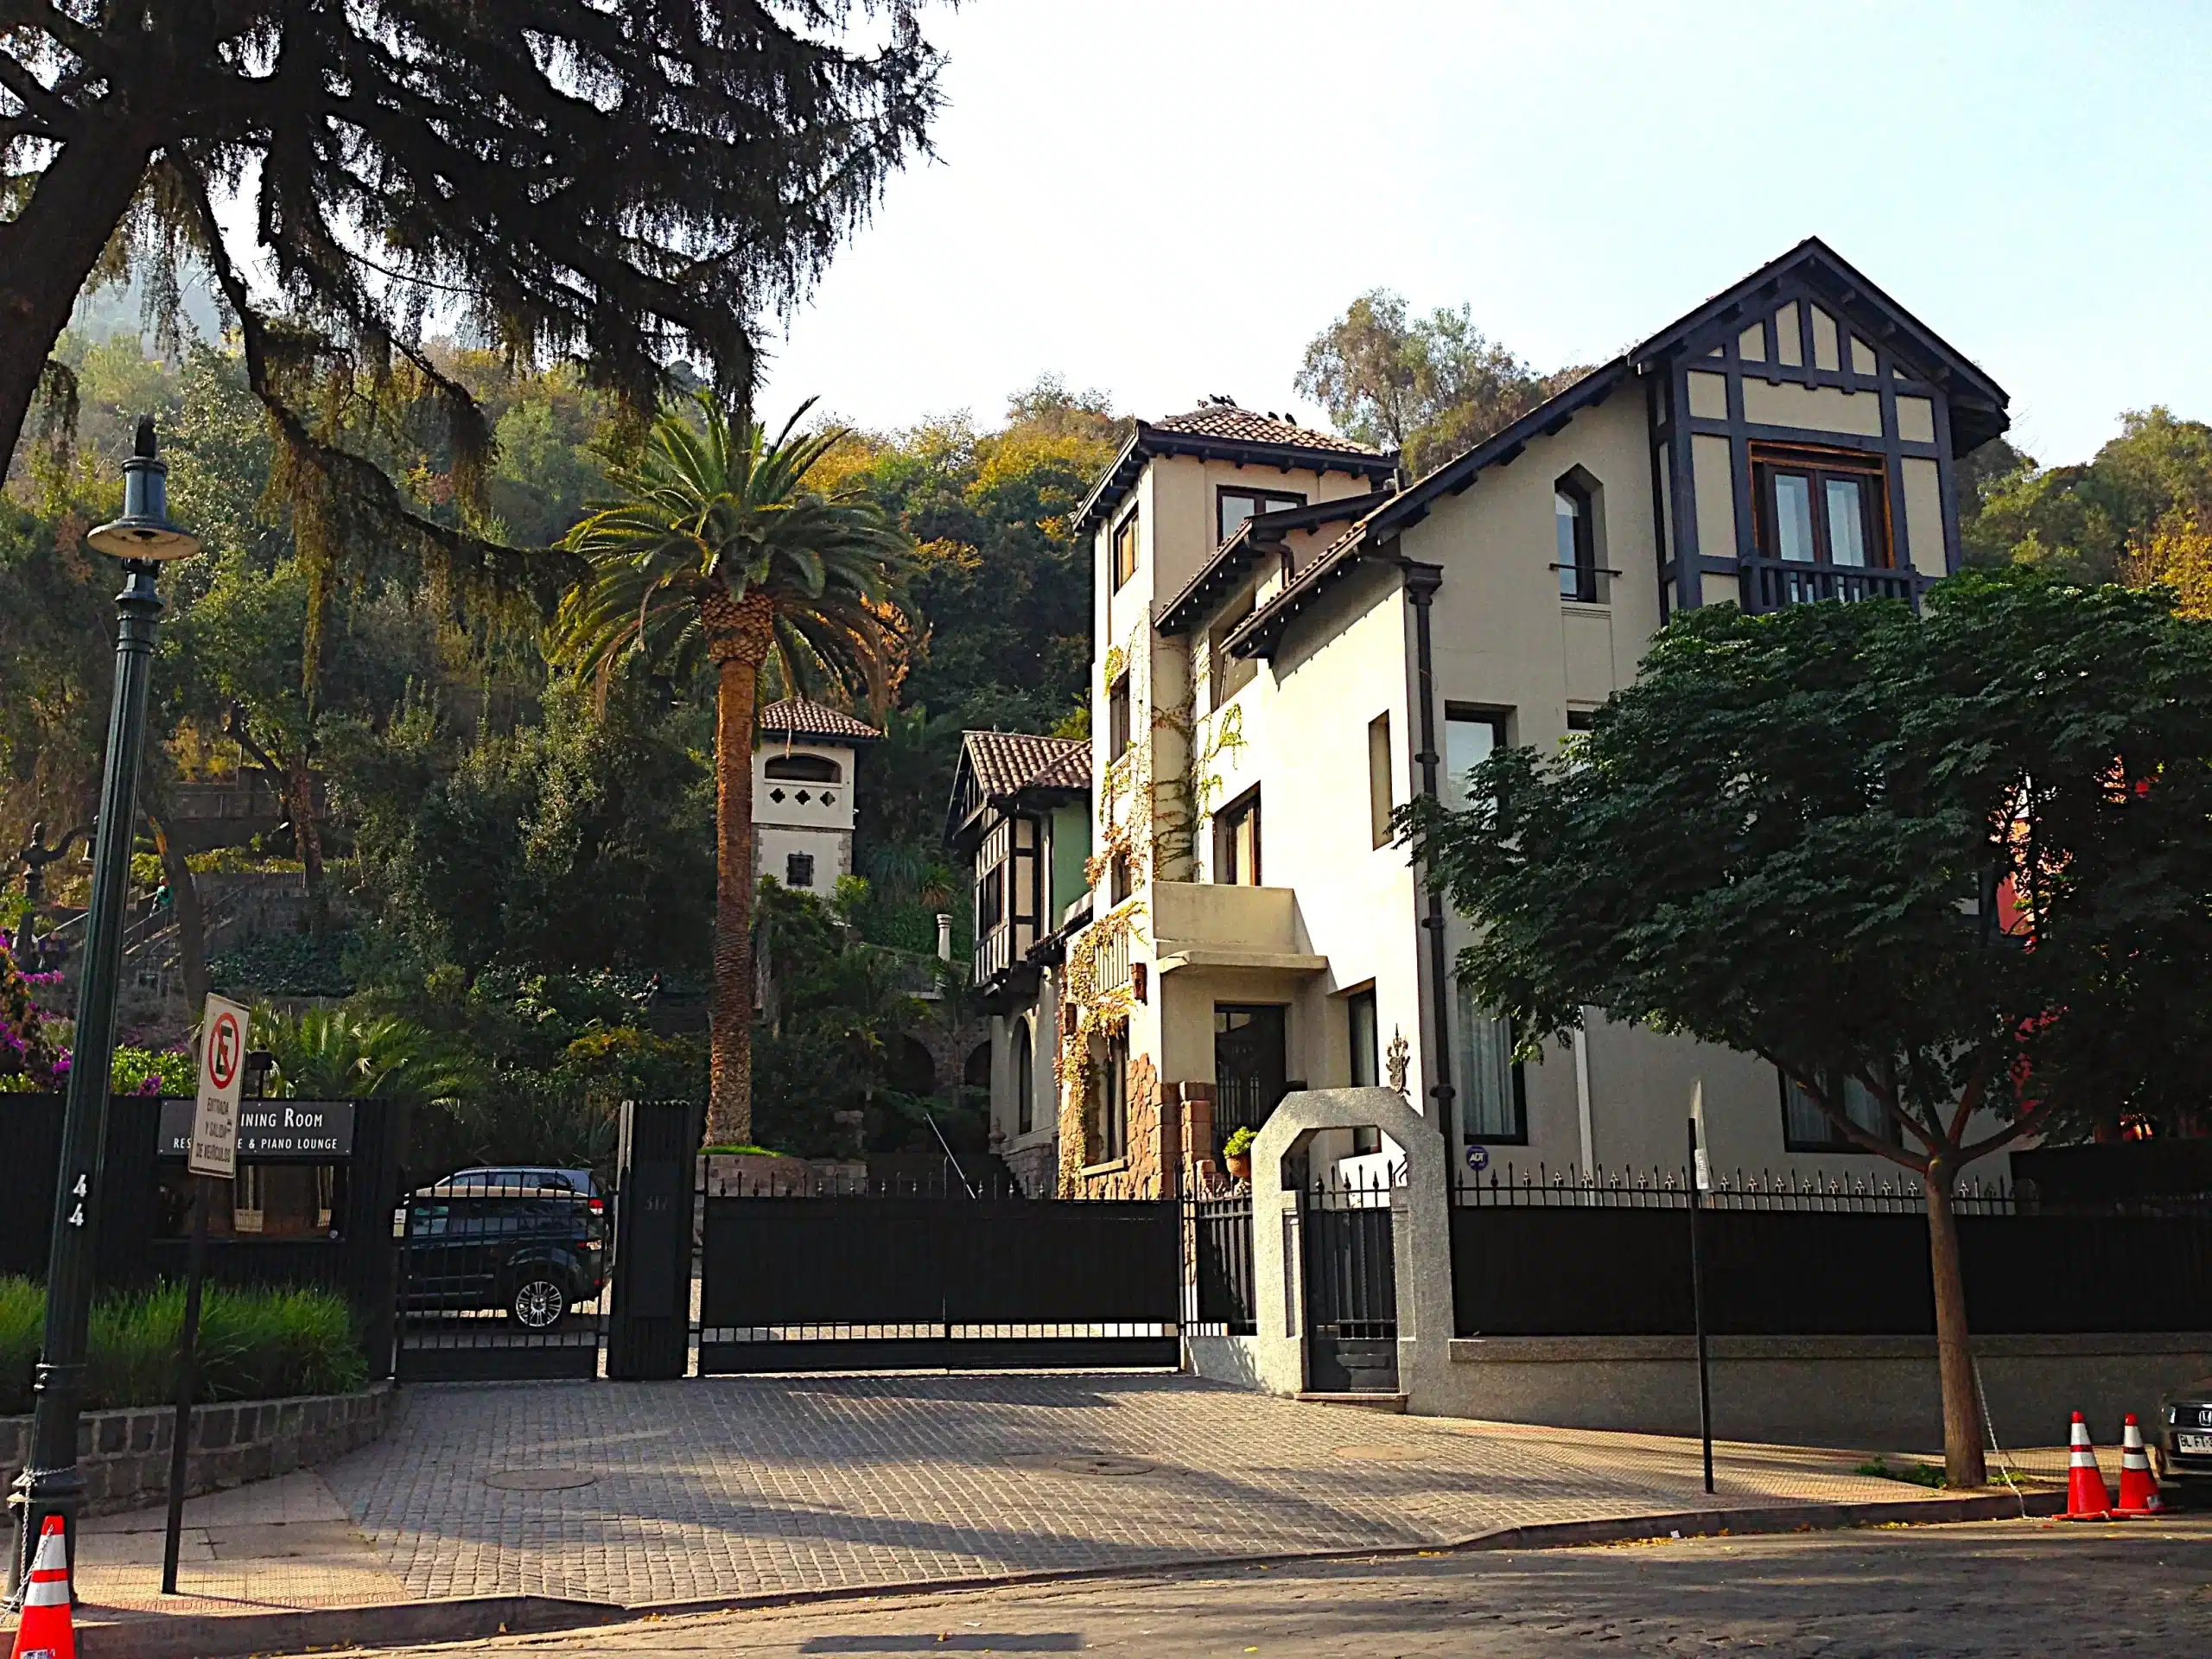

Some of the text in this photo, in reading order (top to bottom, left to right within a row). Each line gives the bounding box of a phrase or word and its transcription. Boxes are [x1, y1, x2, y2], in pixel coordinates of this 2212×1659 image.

[240, 1108, 323, 1128] INING ROOM
[248, 1138, 256, 1149] &
[261, 1138, 292, 1150] PIANO
[297, 1138, 338, 1150] LOUNGE
[1469, 1153, 1484, 1162] ADT
